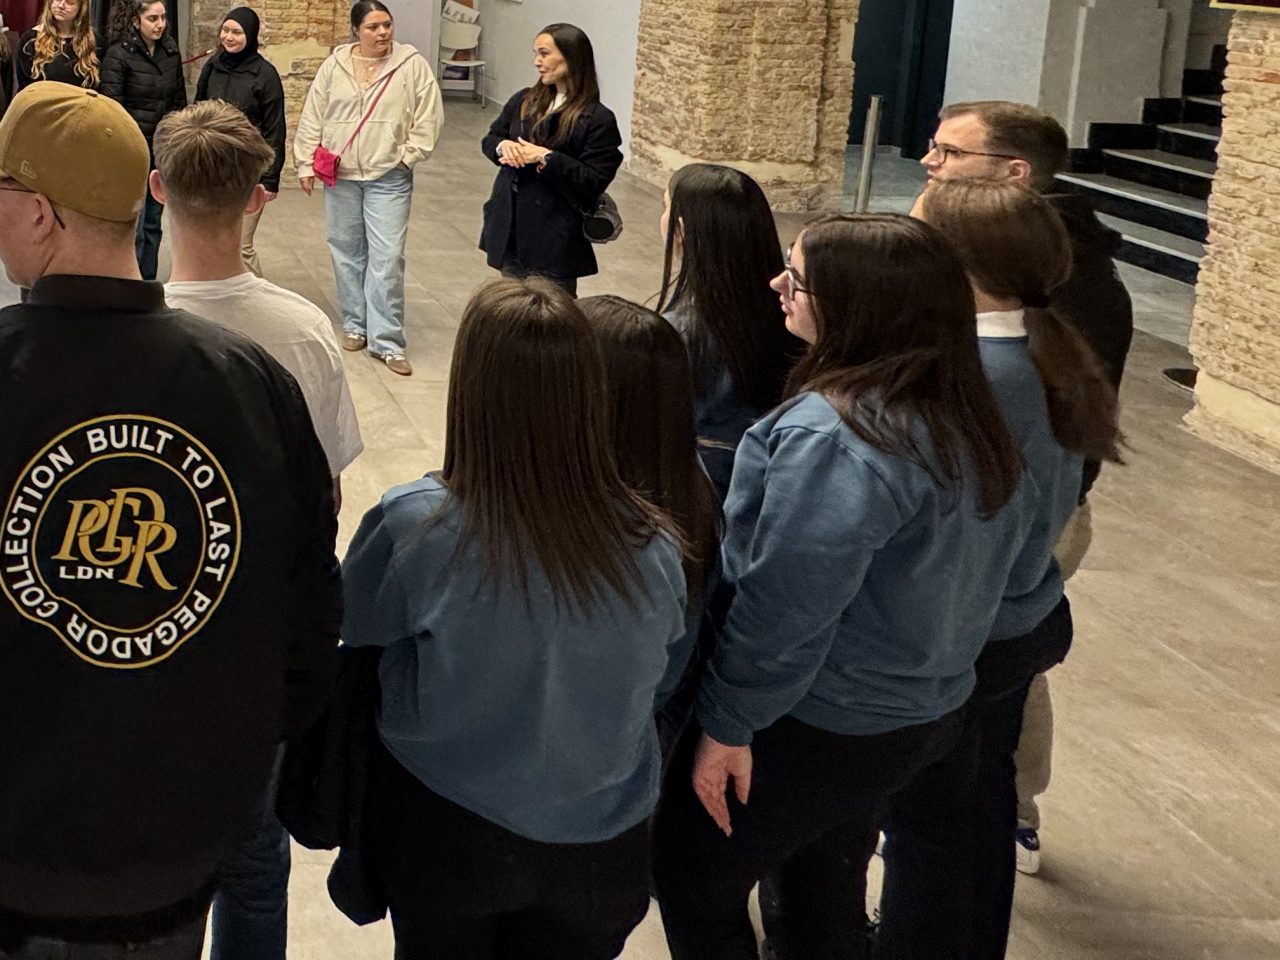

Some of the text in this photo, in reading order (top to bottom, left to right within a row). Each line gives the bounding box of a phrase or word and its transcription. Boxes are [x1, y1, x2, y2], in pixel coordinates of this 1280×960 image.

[5, 444, 212, 659] PEGADOR COLLECTION
[59, 565, 115, 580] LDN
[86, 424, 232, 582] BUILT TO LAST
